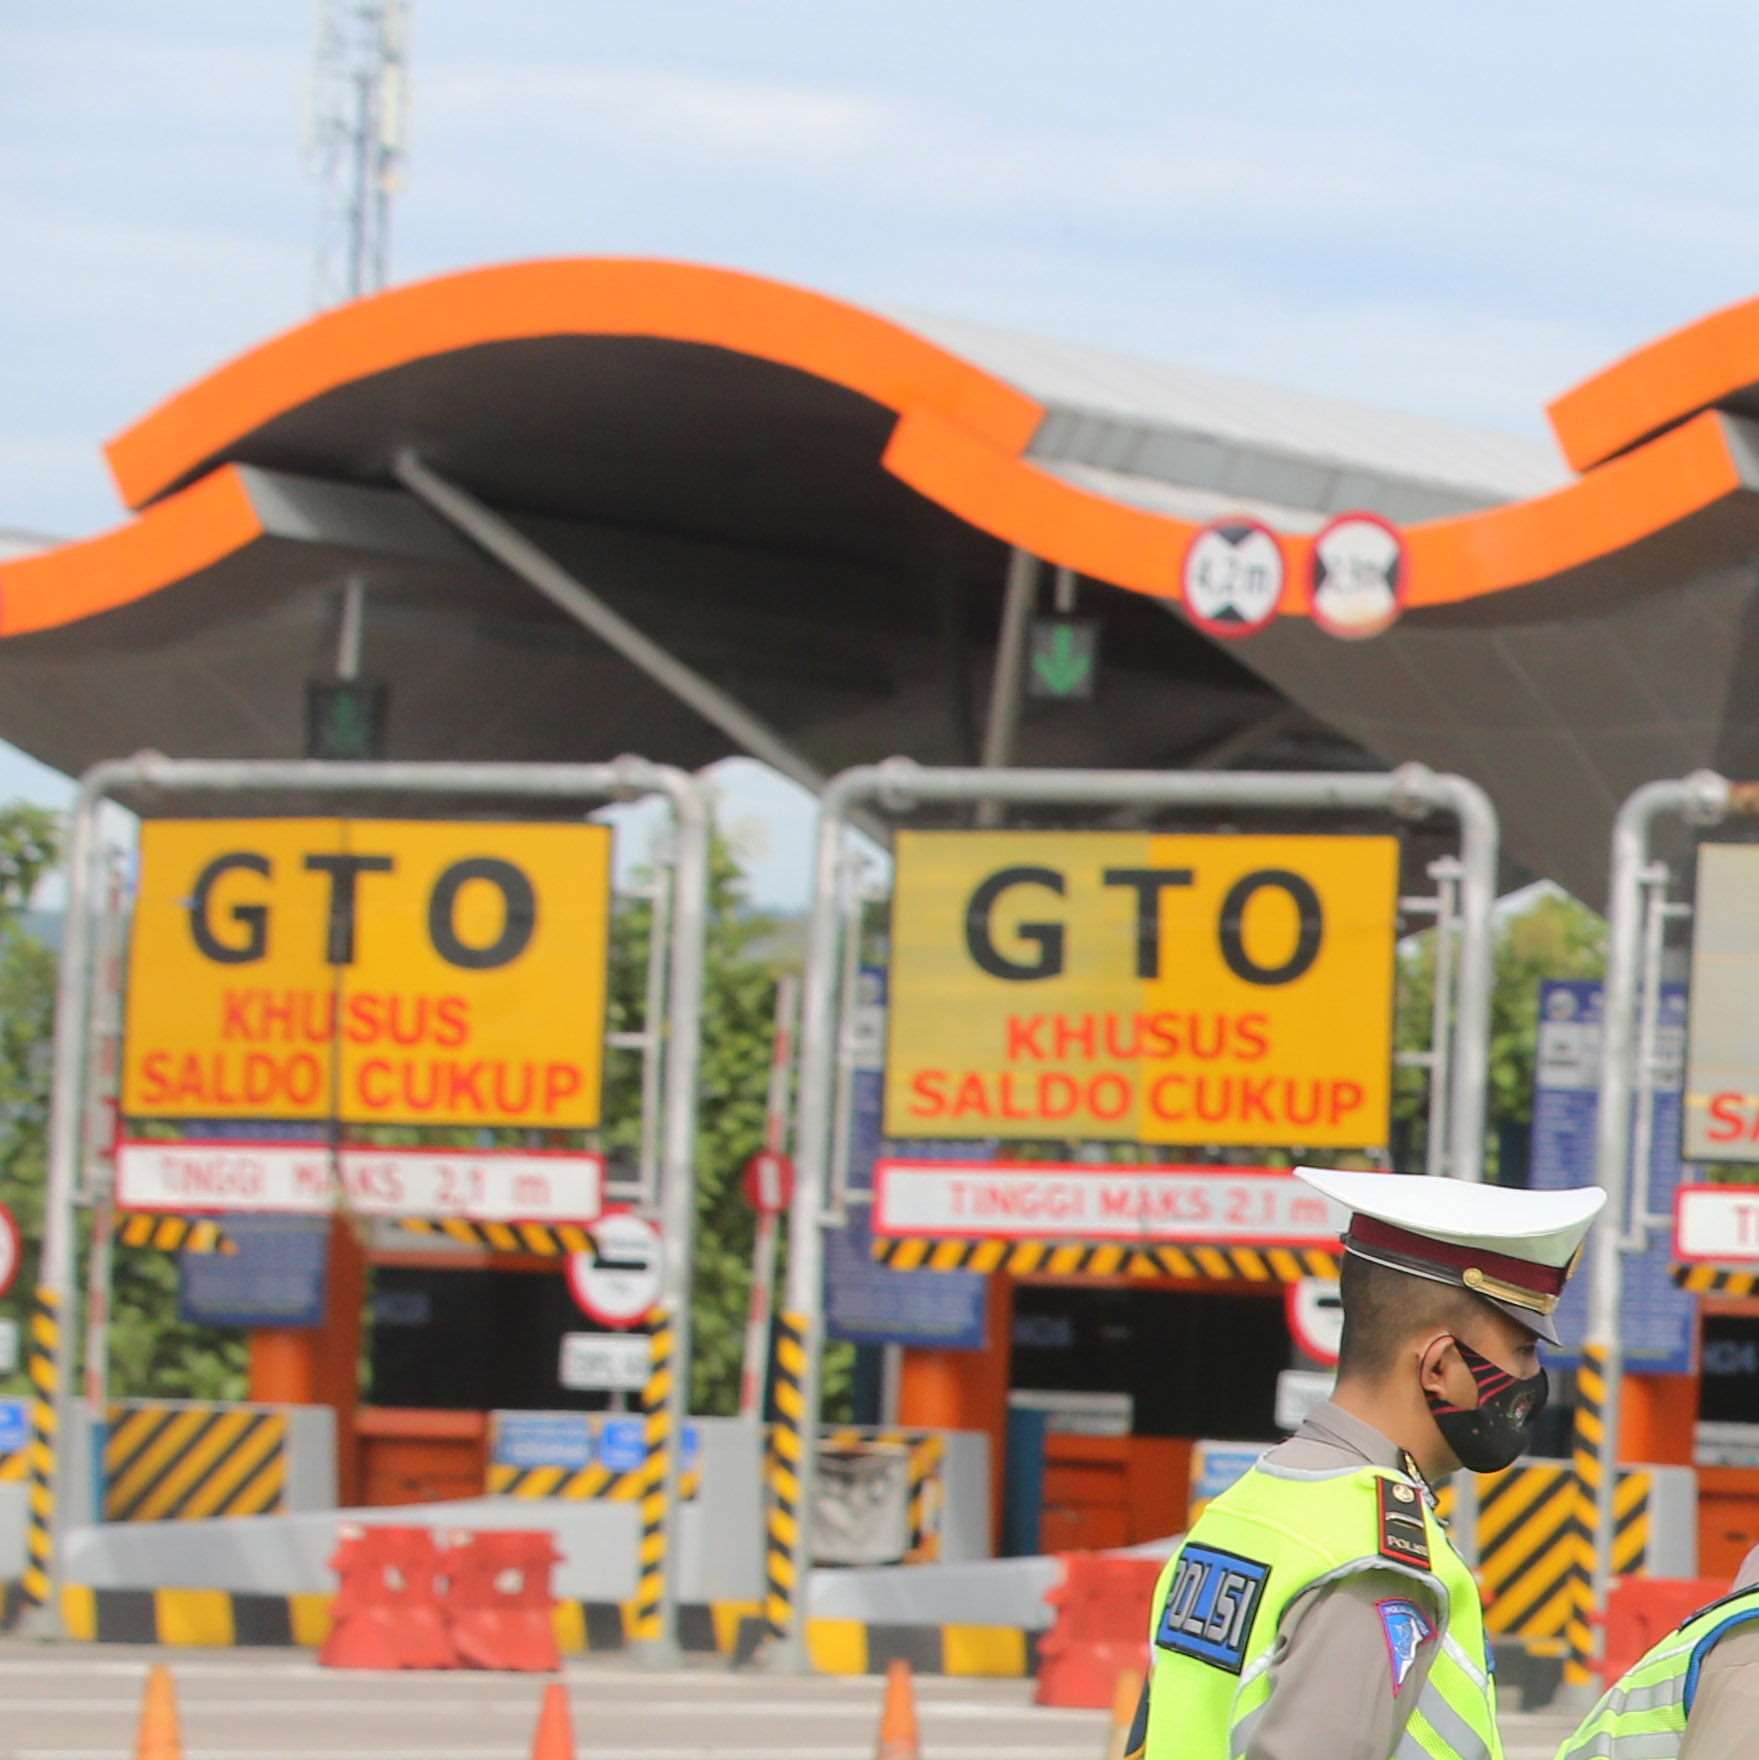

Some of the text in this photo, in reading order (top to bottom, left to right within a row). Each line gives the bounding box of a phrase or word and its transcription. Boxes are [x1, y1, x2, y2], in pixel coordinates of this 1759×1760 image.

[187, 851, 540, 970] GTO
[964, 866, 1326, 987] GTO
[220, 990, 471, 1050] KHUSUS
[1005, 1012, 1271, 1064] KHUSUS
[140, 1052, 584, 1117] SALDO CUKUP
[907, 1070, 1368, 1129] SALDO CUKUP
[512, 1173, 551, 1208] m
[947, 1180, 1086, 1220] TINGGI
[1100, 1183, 1211, 1223] MAKS
[1289, 1197, 1329, 1226] m
